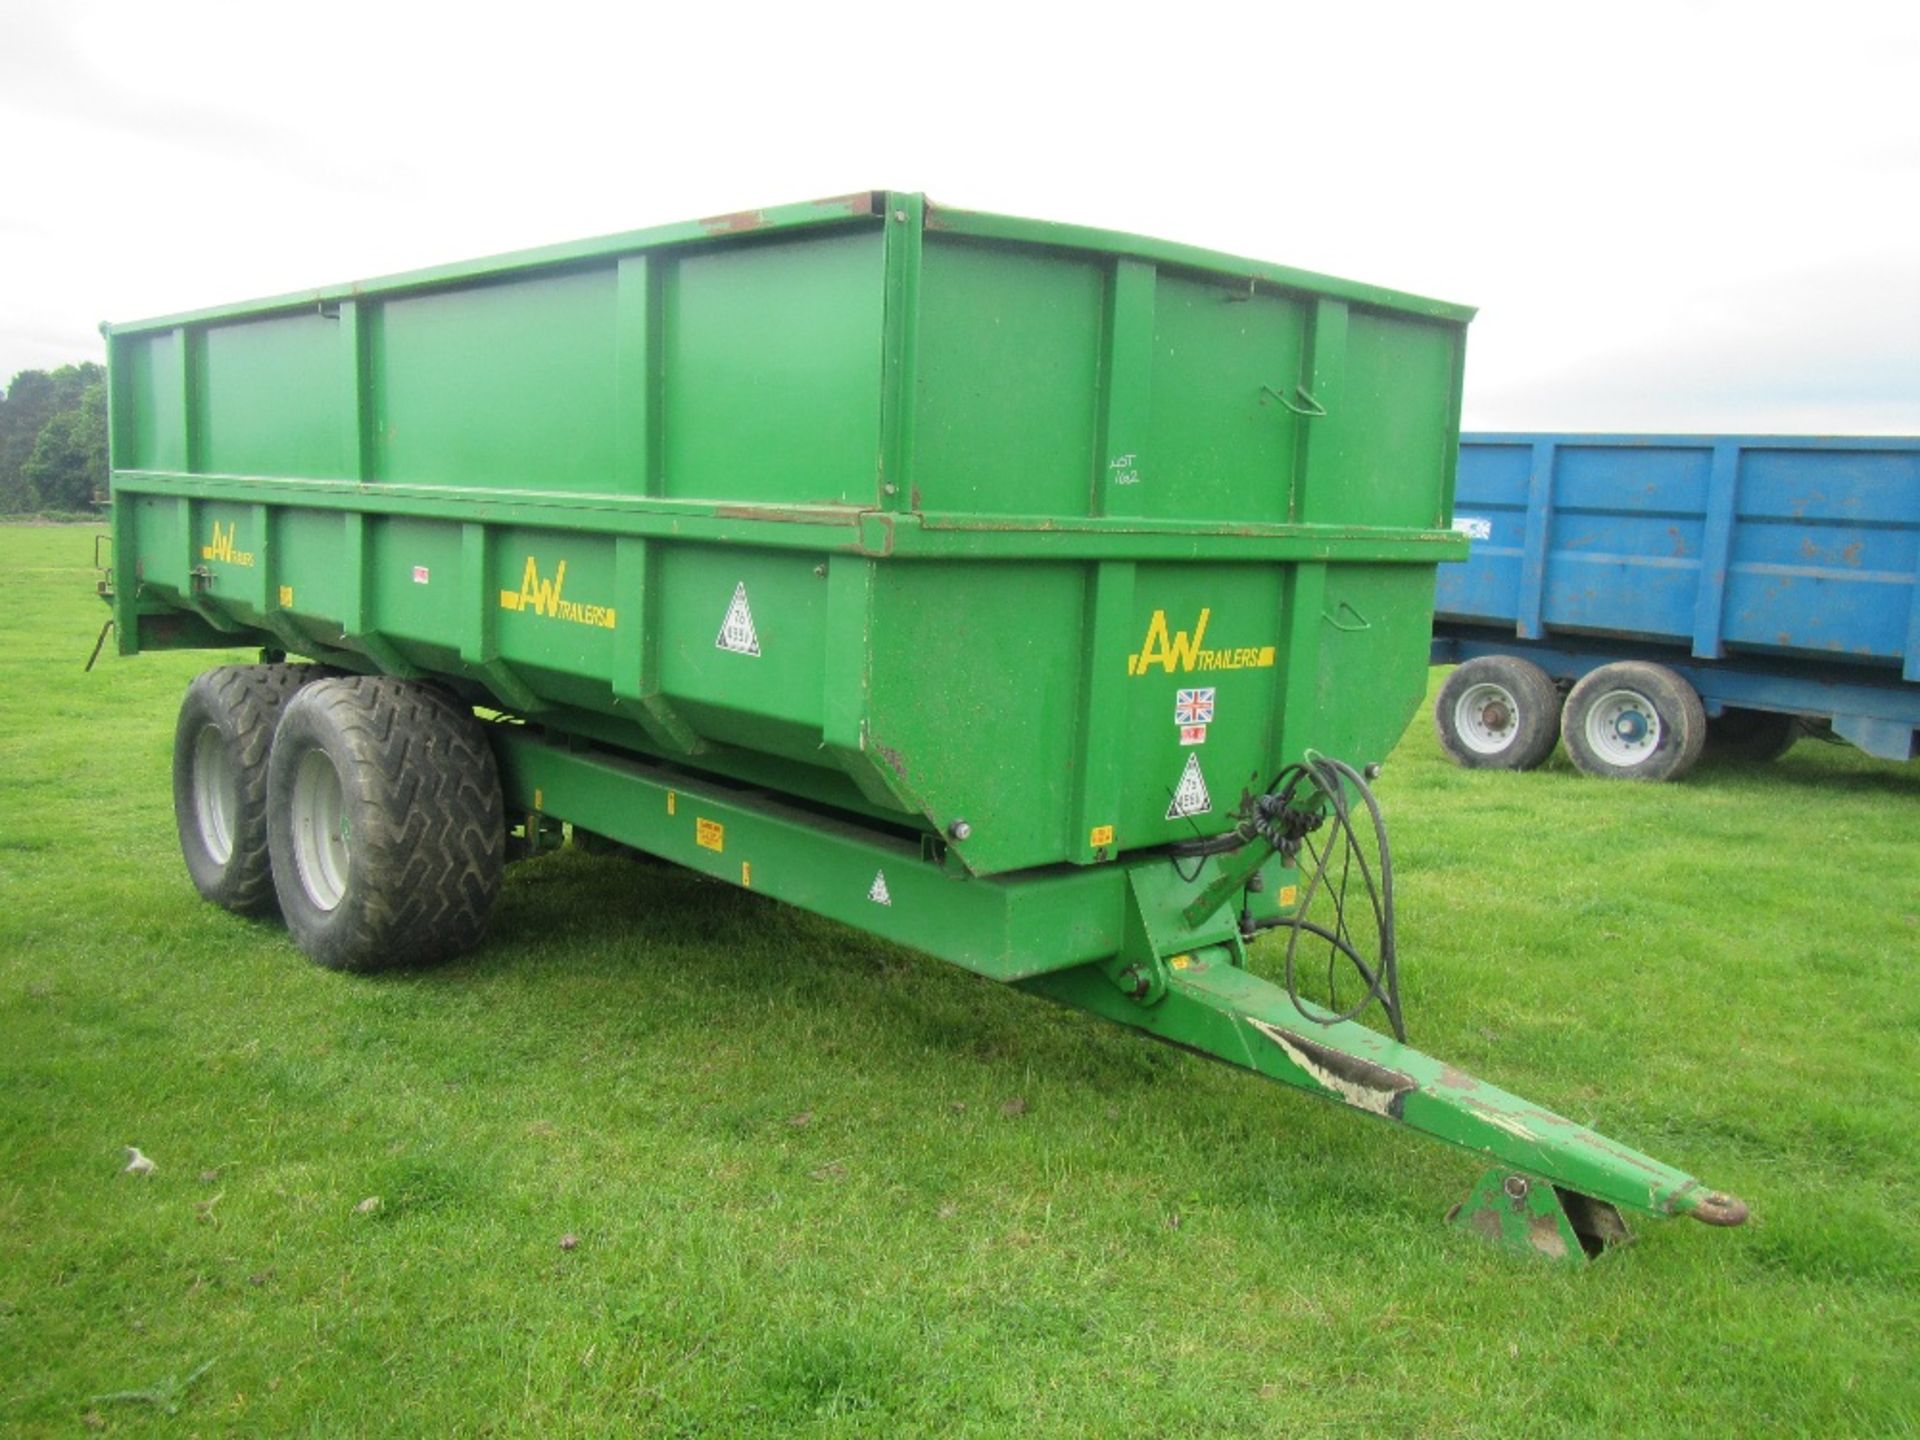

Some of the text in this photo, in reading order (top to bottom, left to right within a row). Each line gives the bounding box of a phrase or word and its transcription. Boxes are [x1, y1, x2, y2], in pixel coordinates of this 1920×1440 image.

[211, 520, 235, 563] AW
[518, 555, 609, 627] AW TRAILERS
[1135, 607, 1259, 675] AW TRAILERS
